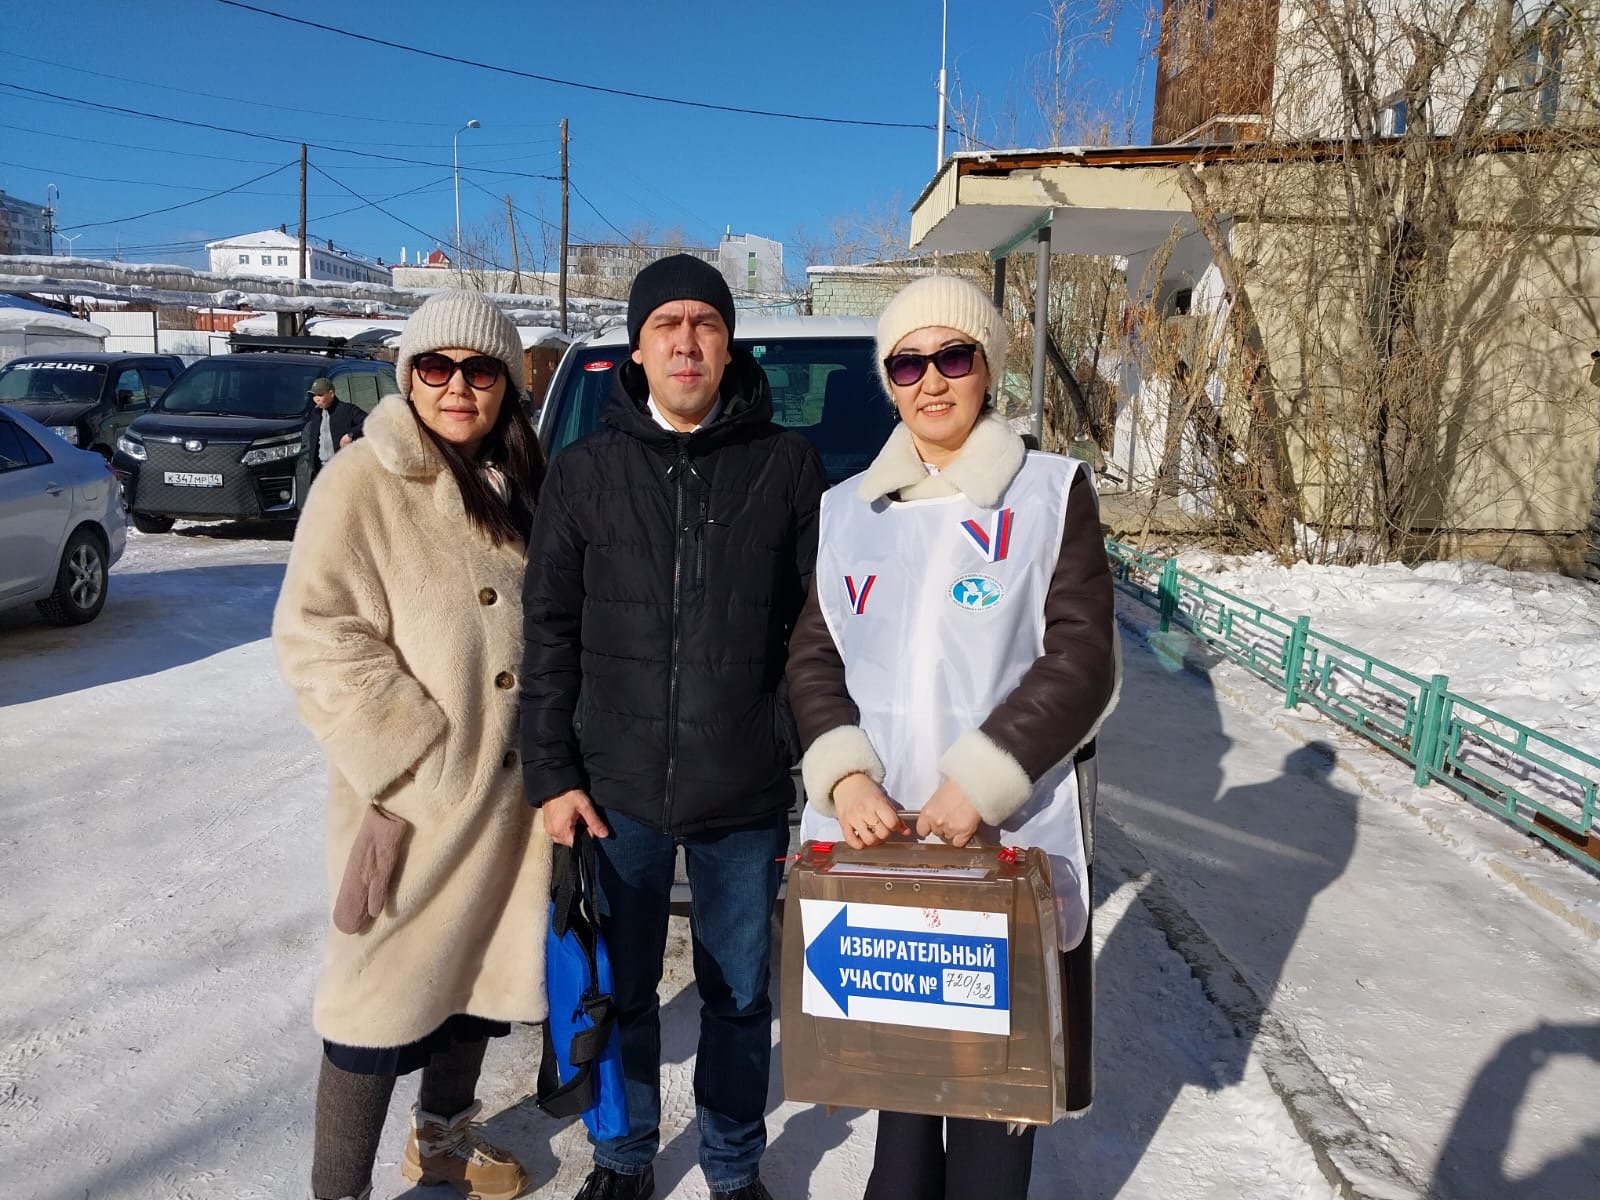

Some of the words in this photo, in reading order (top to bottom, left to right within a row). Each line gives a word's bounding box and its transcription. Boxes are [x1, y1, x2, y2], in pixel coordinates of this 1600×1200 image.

[14, 362, 95, 372] SUZUKI
[839, 935, 996, 968] ИЗБИРАТЕЛЬНЫЙ
[838, 967, 915, 994] УЧАСТОК
[919, 975, 937, 995] №
[945, 971, 993, 1000] 720/32
